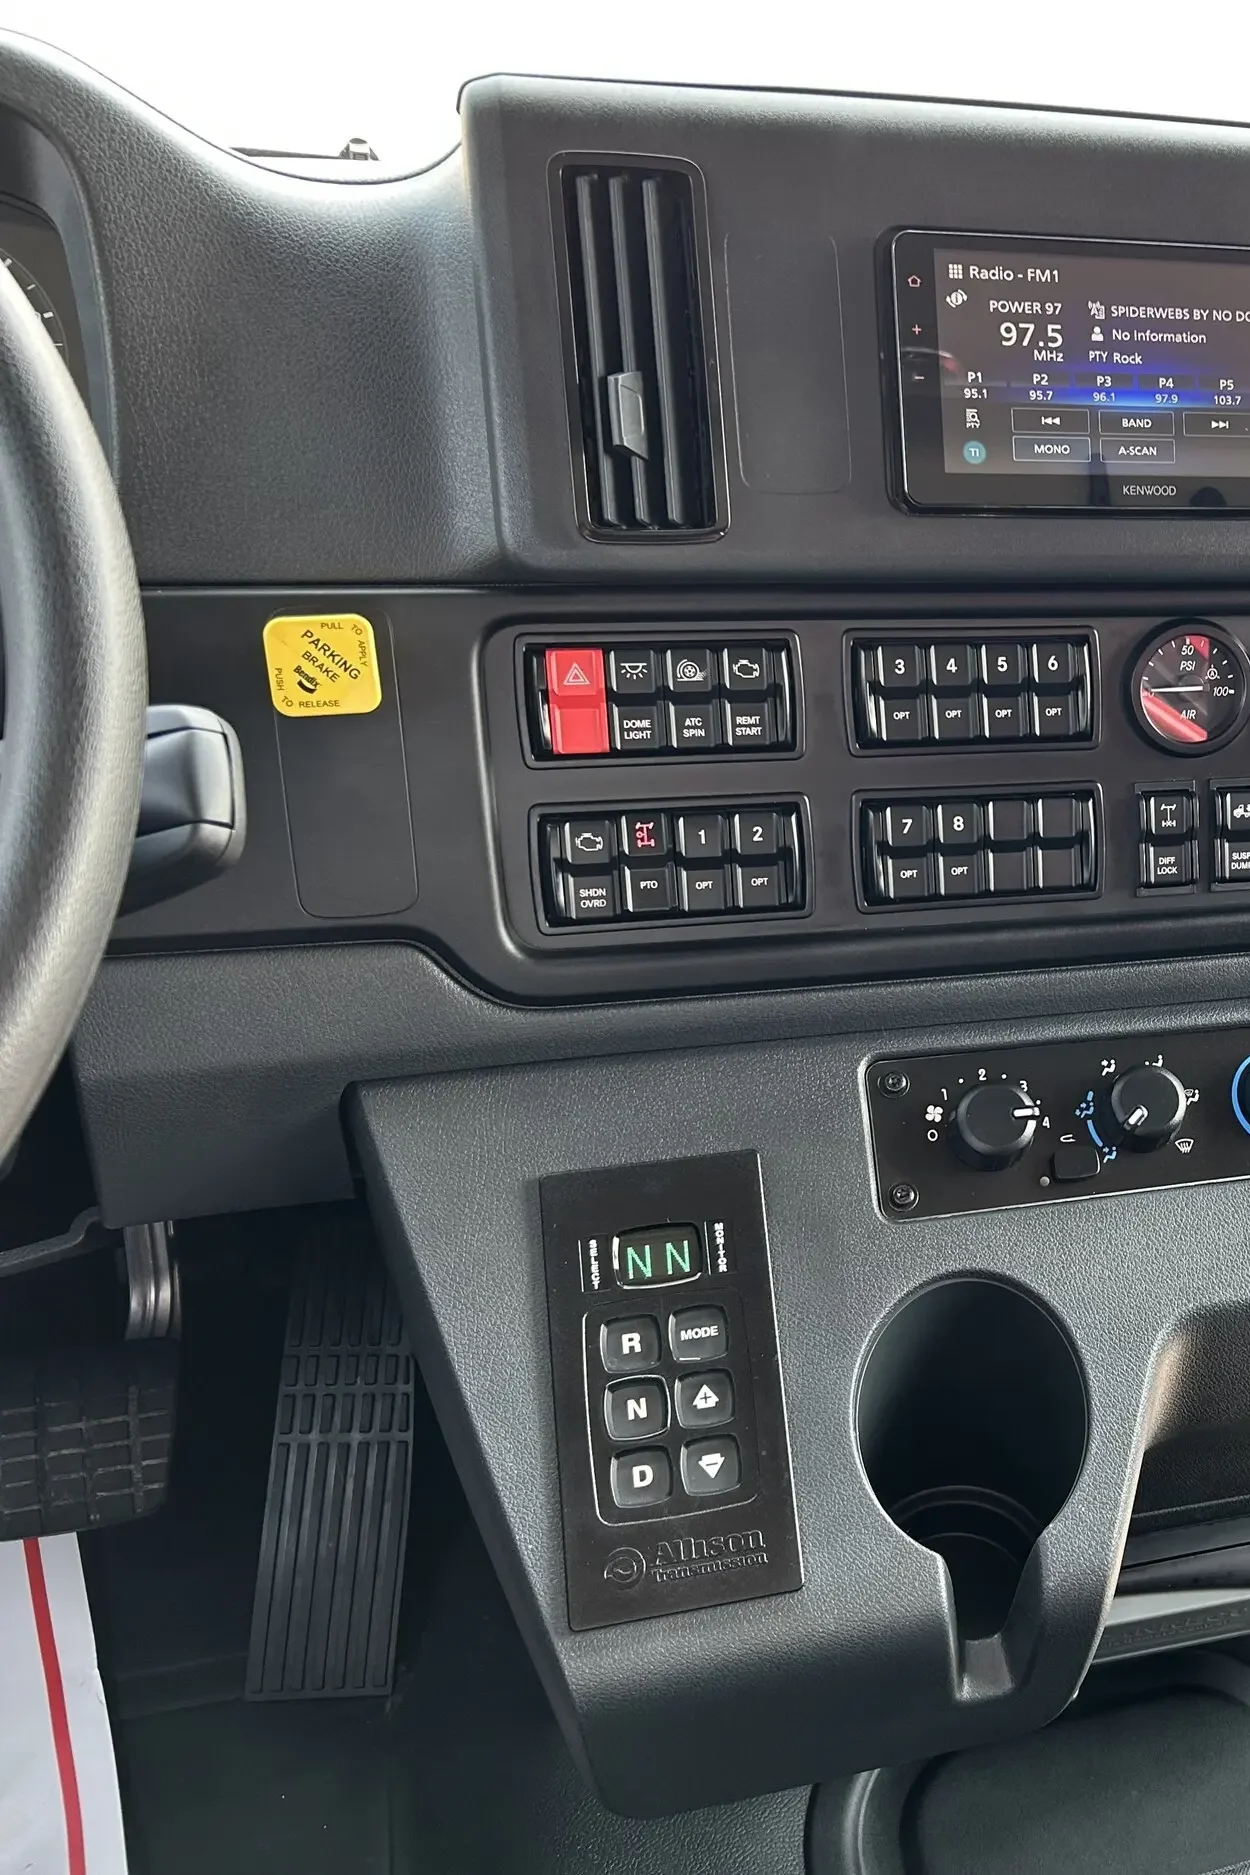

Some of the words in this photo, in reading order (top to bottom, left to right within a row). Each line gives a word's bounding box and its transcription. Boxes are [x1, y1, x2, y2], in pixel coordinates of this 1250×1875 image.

[969, 266, 1014, 281] Radio
[1027, 269, 1059, 282] FM1
[989, 300, 1042, 314] POWER
[1045, 303, 1062, 315] 97
[1111, 305, 1189, 320] SPIDERWEBS
[1193, 310, 1209, 321] BY
[1212, 310, 1232, 322] NO
[1000, 322, 1063, 347] 97.5
[1113, 329, 1130, 341] No
[1134, 330, 1207, 343] Information
[1034, 350, 1063, 362] MHz
[1089, 351, 1108, 362] PTY
[1113, 352, 1142, 364] Rock
[968, 372, 982, 383] P1
[1033, 374, 1049, 385] P2
[1096, 375, 1112, 386] P3
[1158, 378, 1174, 389] P4
[1219, 379, 1234, 390] P5
[964, 388, 988, 399] 95.1
[1029, 391, 1053, 400] 95.7
[1093, 392, 1115, 402] 96.1
[1155, 394, 1178, 404] 97.9
[1214, 396, 1241, 406] 103.7
[1122, 419, 1152, 428] BAND
[1034, 445, 1070, 455] MONO
[1118, 447, 1157, 456] A-SCAN
[1123, 485, 1177, 496] KENWOOD
[320, 622, 344, 630] PULL
[350, 624, 363, 635] TO
[358, 640, 368, 667] APPLY
[1181, 645, 1194, 655] 50
[301, 630, 361, 680] PARKING
[301, 650, 340, 683] BRAKE
[894, 659, 905, 674] 3
[946, 658, 958, 673] 4
[997, 656, 1007, 672] 5
[1048, 655, 1058, 671] 6
[1180, 661, 1196, 671] PSI
[293, 665, 320, 688] Bendix
[275, 667, 284, 691] PUSH
[281, 696, 293, 707] TO
[299, 700, 340, 708] RELEASE
[1213, 687, 1229, 696] 100
[893, 711, 910, 720] OPT
[945, 709, 962, 719] OPT
[995, 709, 1012, 718] OPT
[1045, 708, 1062, 717] OPT
[1180, 710, 1196, 719] AIR
[623, 719, 651, 728] DOME
[685, 718, 702, 727] ATC
[736, 716, 760, 725] REMT
[624, 730, 651, 739] LIGHT
[683, 728, 705, 737] SPIN
[735, 726, 762, 735] START
[901, 819, 913, 834] 7
[953, 816, 964, 831] 8
[698, 830, 706, 844] 1
[752, 827, 763, 842] 2
[1159, 857, 1175, 865] DIFF
[1232, 852, 1250, 860] SUSP
[900, 869, 918, 879] OPT
[951, 866, 968, 876] OPT
[1157, 866, 1177, 875] LOCK
[640, 880, 658, 890] PTO
[696, 881, 713, 890] OPT
[751, 877, 768, 887] OPT
[579, 888, 606, 898] SHDN
[580, 899, 606, 908] OVRD
[978, 1068, 987, 1081] 2
[1020, 1080, 1027, 1092] 3
[941, 1088, 947, 1100] 1
[1042, 1116, 1050, 1128] 4
[714, 1222, 727, 1272] MONITOR
[589, 1239, 600, 1290] SELECT
[627, 1245, 652, 1280] N
[665, 1240, 690, 1275] N
[680, 1325, 719, 1341] MODE
[621, 1332, 641, 1354] R
[627, 1398, 648, 1420] N
[632, 1465, 654, 1488] D
[652, 1529, 766, 1566] Allison
[650, 1552, 768, 1582] Transmission
